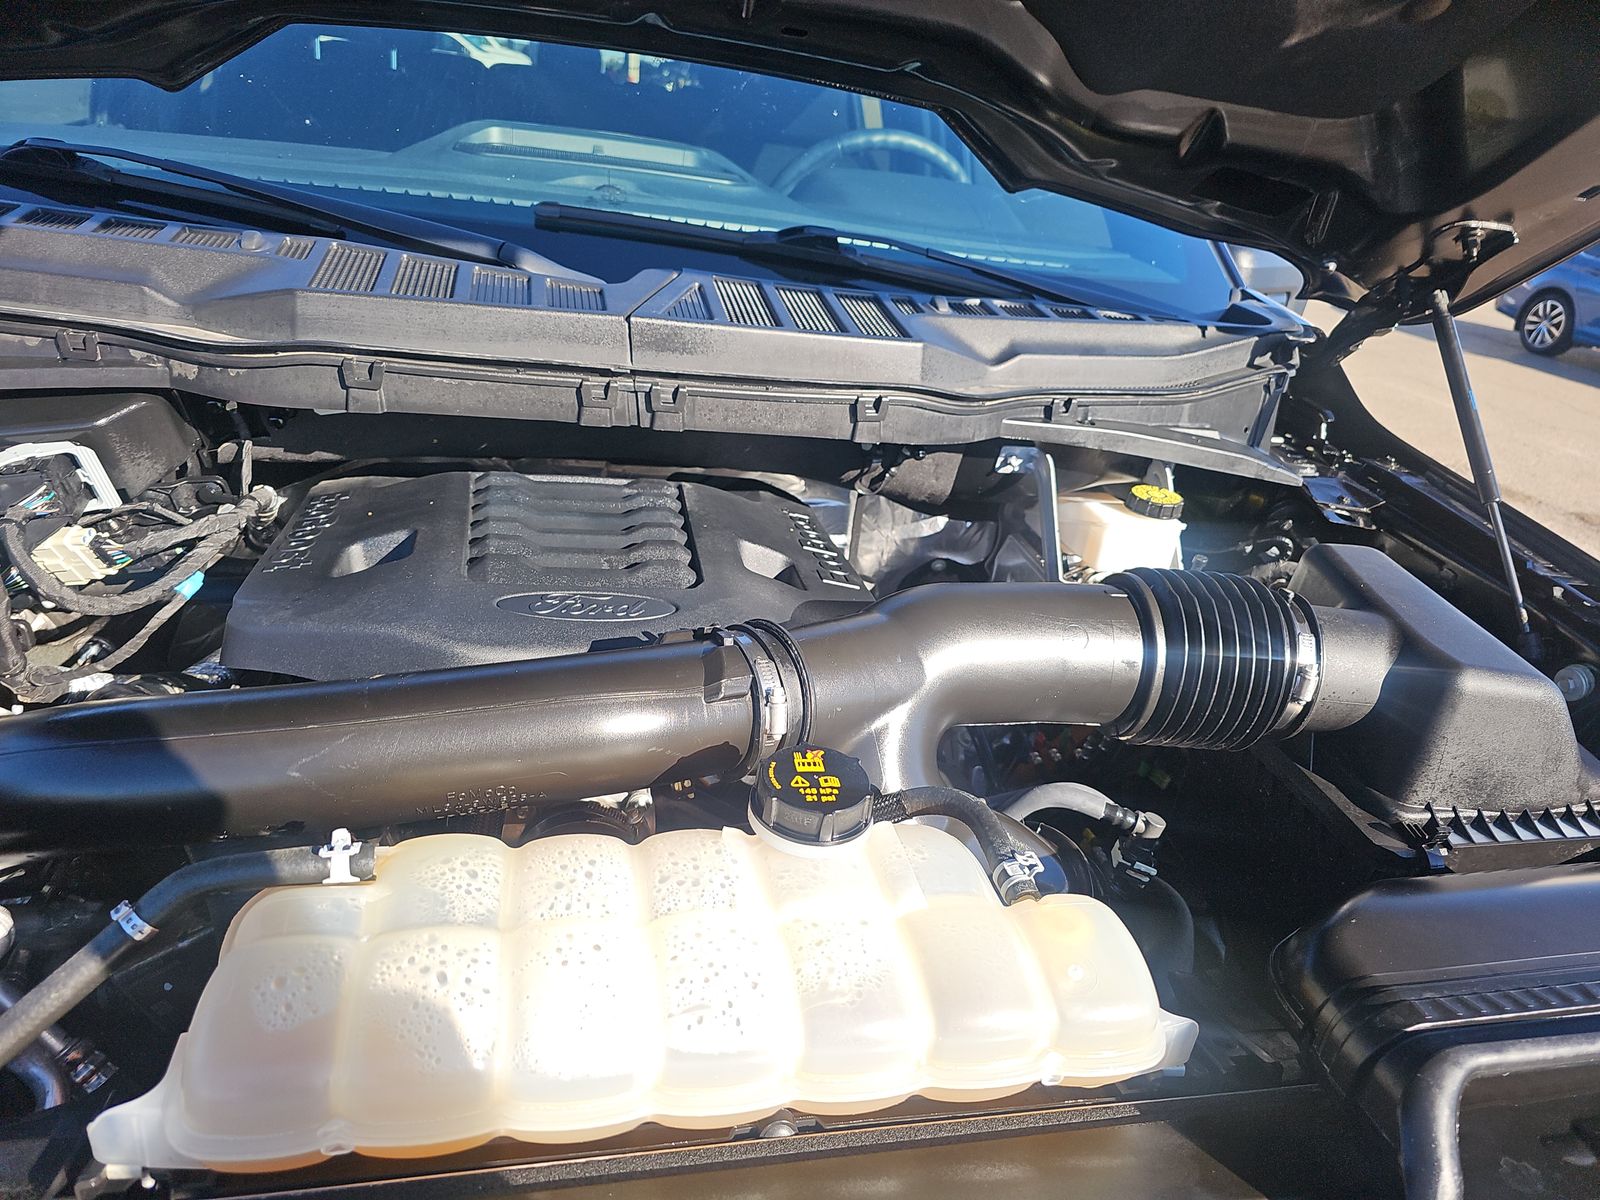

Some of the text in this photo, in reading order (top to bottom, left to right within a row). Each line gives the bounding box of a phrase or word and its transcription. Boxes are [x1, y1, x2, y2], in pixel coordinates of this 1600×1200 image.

[528, 592, 649, 618] Ford
[446, 784, 518, 802] FoMoCo
[819, 787, 840, 795] kPa
[821, 795, 837, 803] psi
